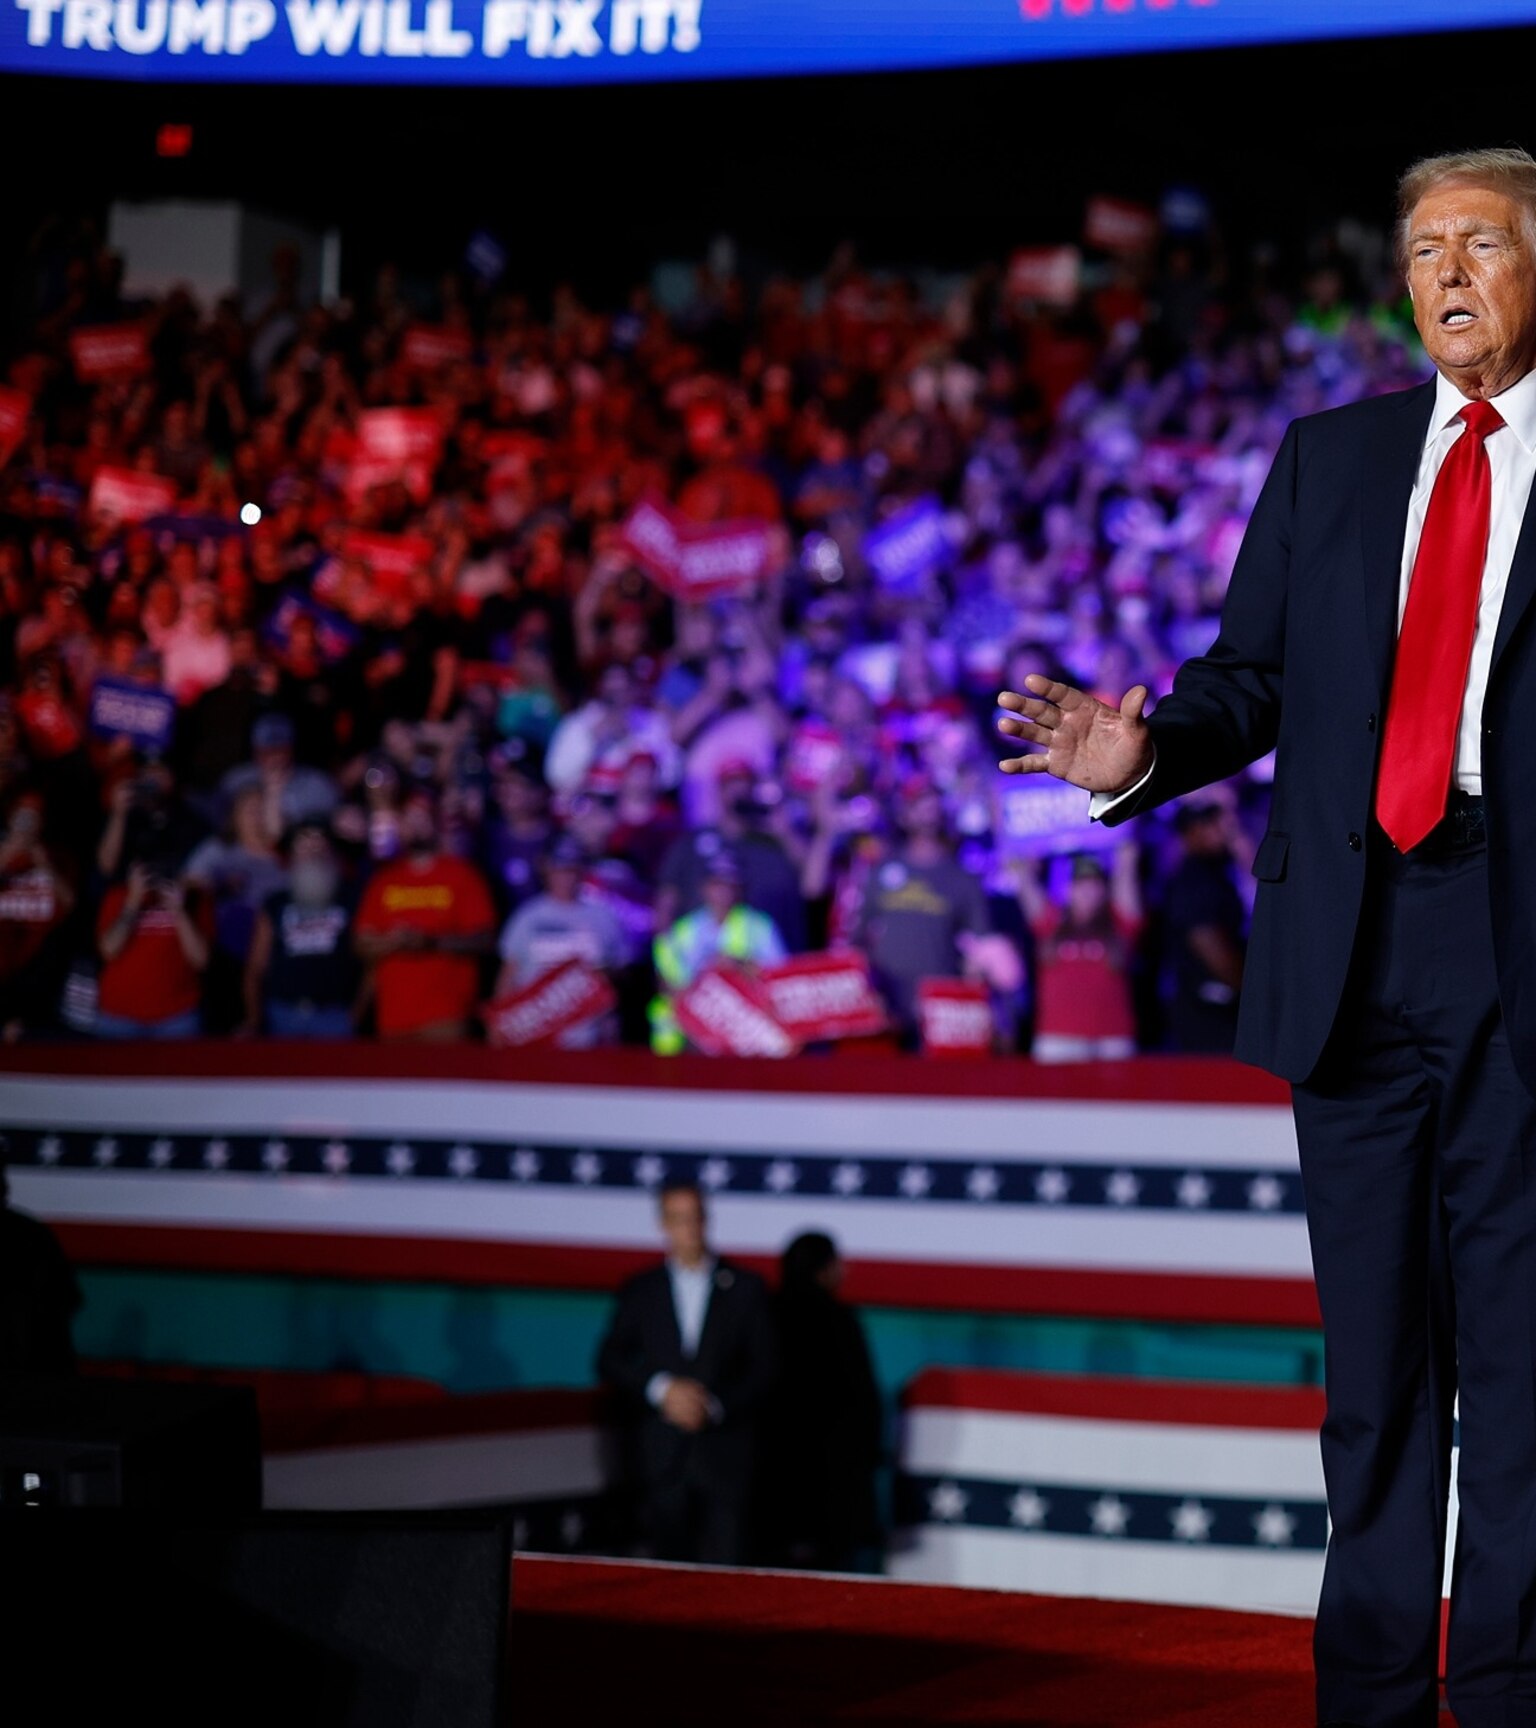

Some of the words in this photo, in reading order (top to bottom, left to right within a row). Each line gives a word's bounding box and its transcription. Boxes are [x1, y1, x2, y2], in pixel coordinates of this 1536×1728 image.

[19, 0, 276, 56] TRUMP
[288, 0, 472, 57] WILL
[482, 0, 603, 58] FIX
[609, 0, 701, 56] IT!
